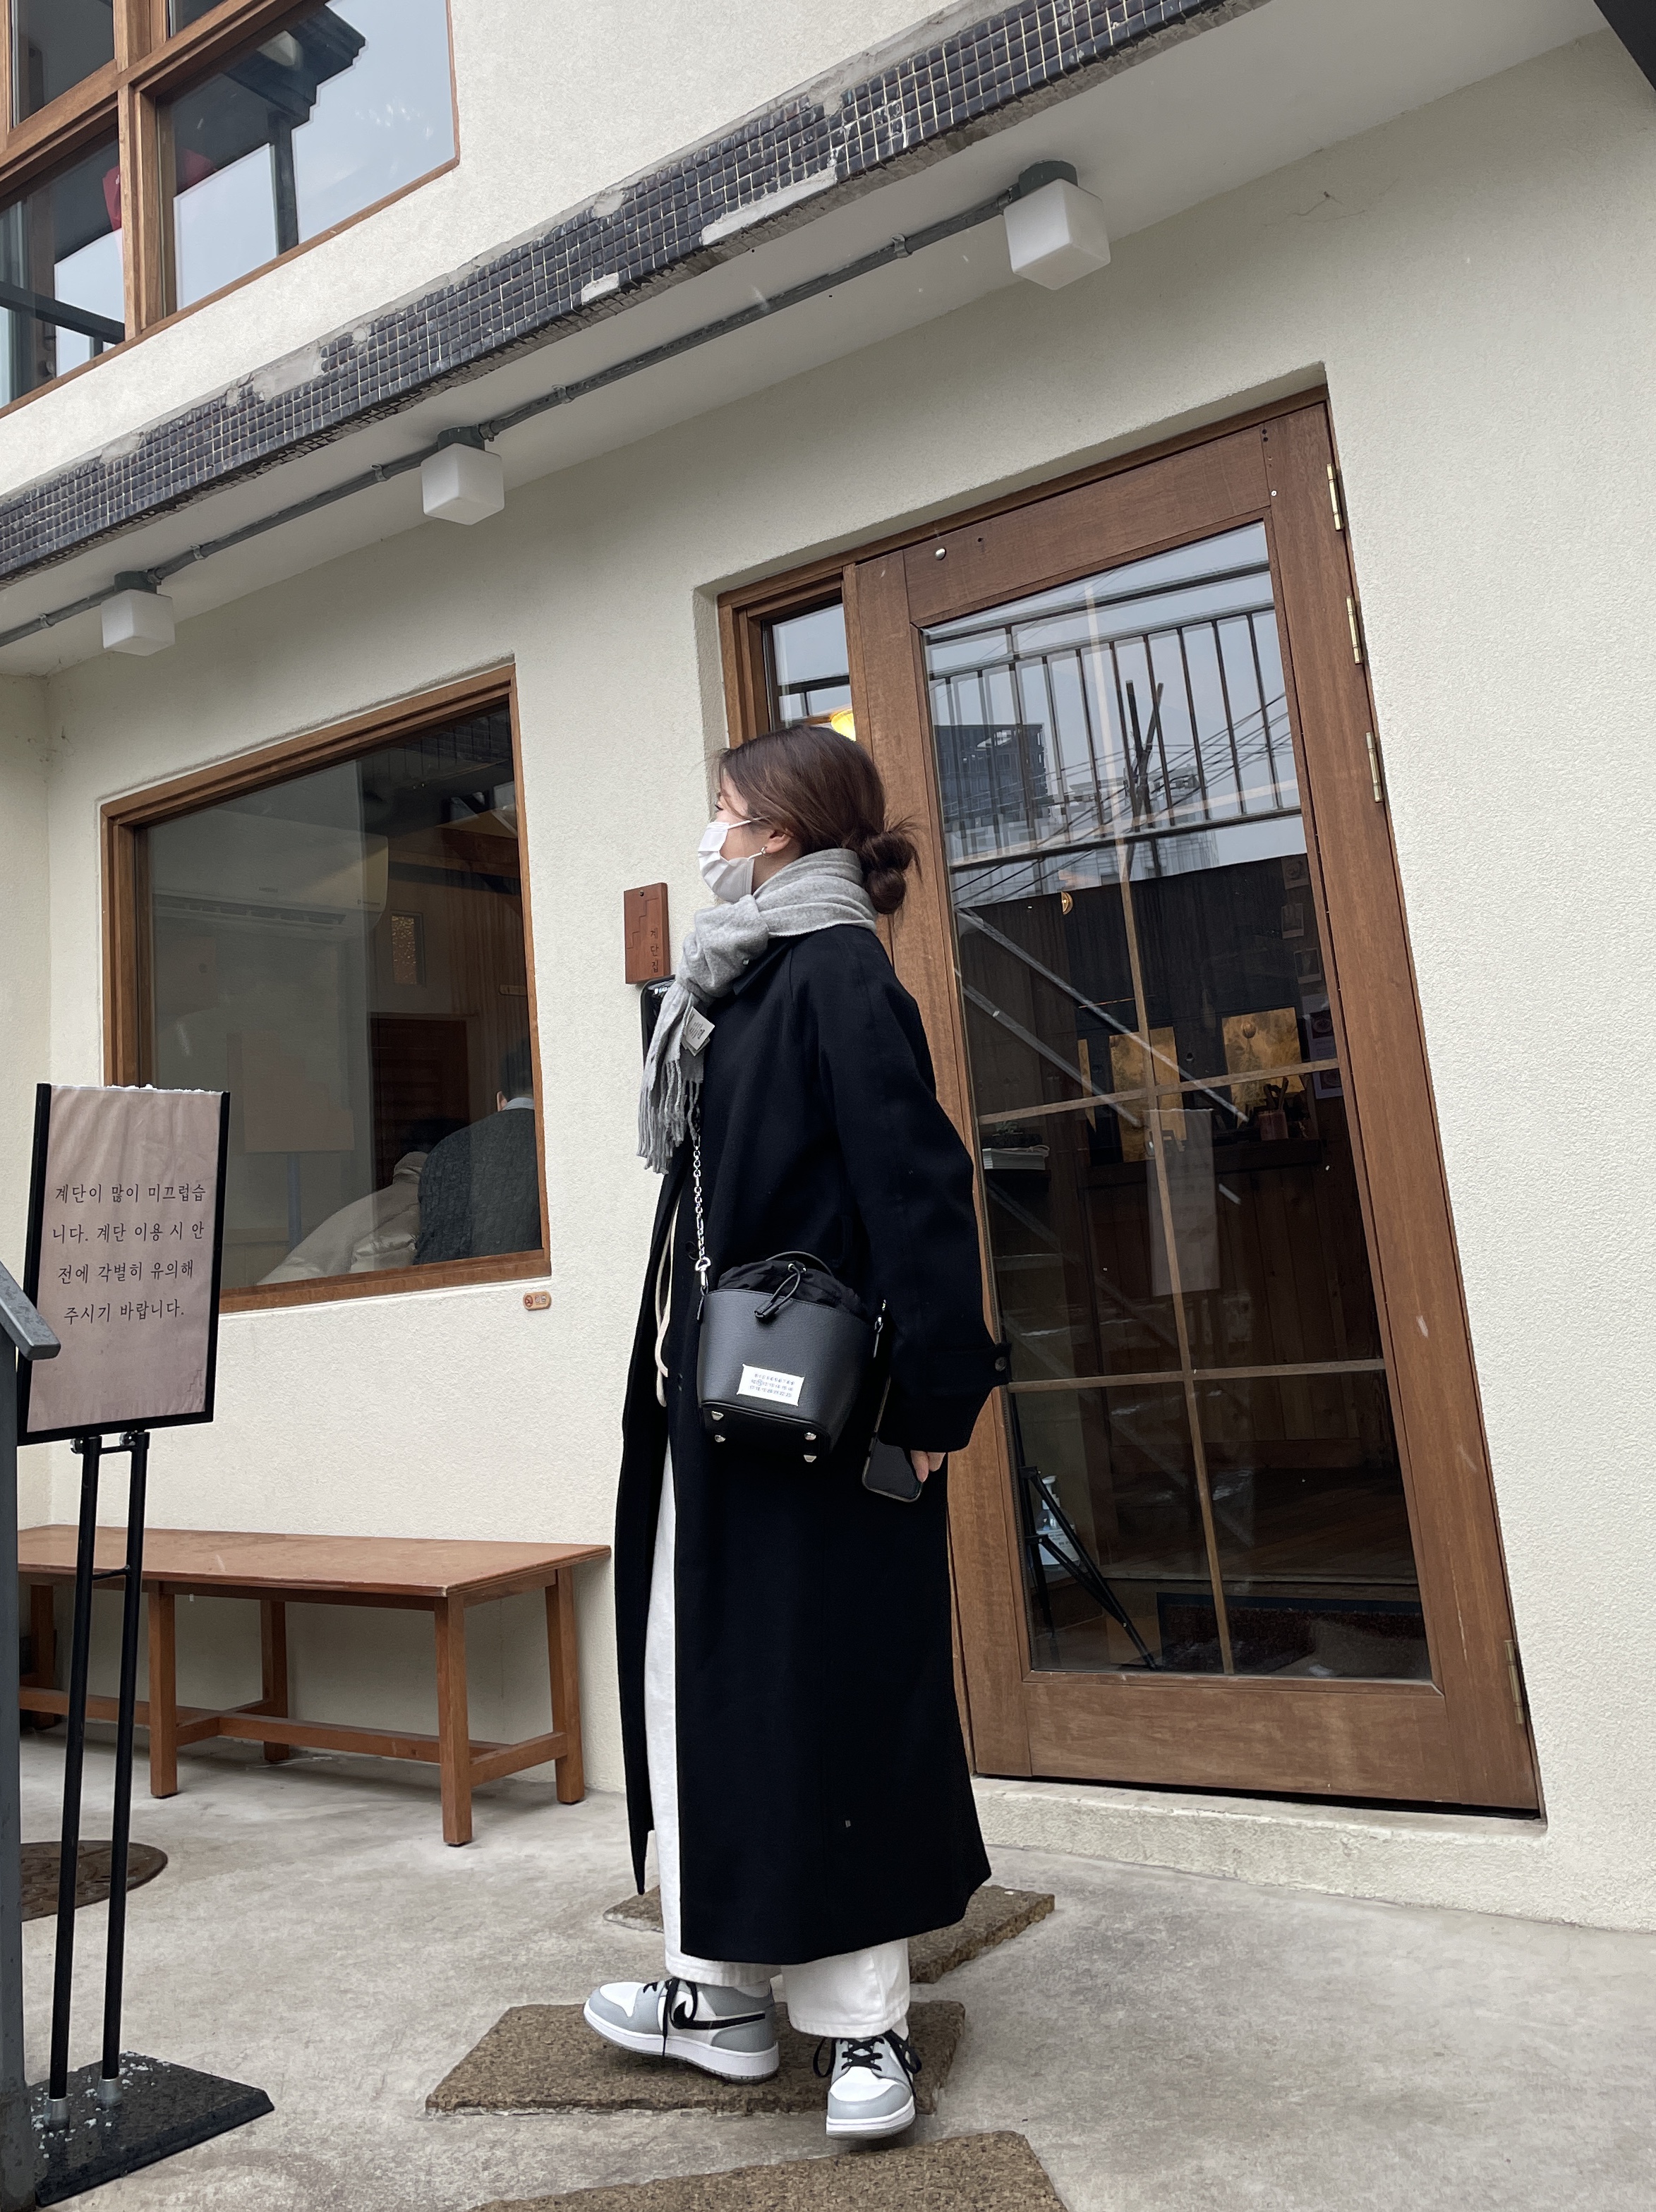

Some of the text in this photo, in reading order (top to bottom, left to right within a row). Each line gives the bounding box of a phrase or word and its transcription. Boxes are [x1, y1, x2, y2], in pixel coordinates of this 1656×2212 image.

[651, 928, 659, 973] 계단집
[56, 1183, 205, 1203] 계단이 많이 미끄럽습
[53, 1221, 204, 1244] 니다. 계단 이용 시 안
[59, 1259, 193, 1284] 전에 각별히 유의해
[64, 1299, 183, 1325] 주시기 바랍니다.
